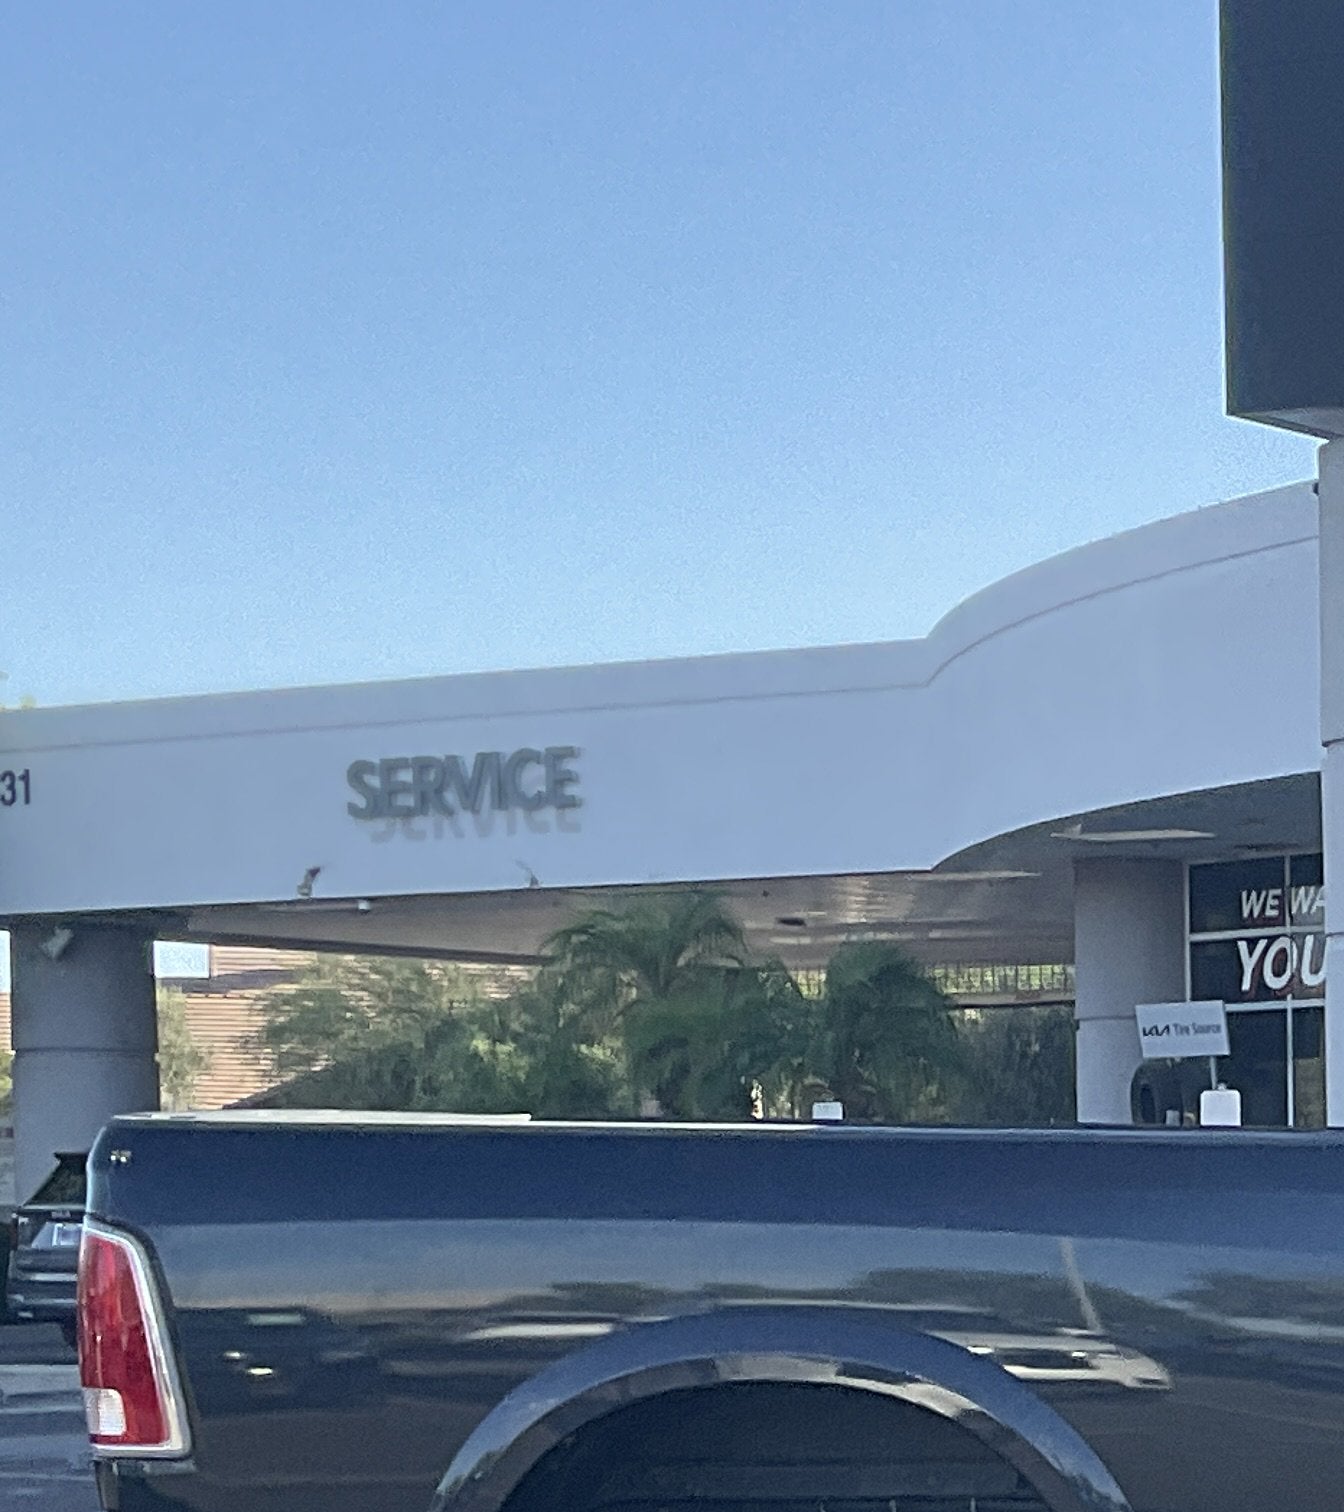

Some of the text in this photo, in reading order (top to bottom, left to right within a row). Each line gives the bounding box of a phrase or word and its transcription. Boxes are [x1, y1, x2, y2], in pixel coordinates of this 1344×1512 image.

[346, 745, 586, 821] SERVICE
[1241, 888, 1282, 918] WE
[1237, 934, 1326, 992] YOU
[1142, 1024, 1170, 1037] KIA
